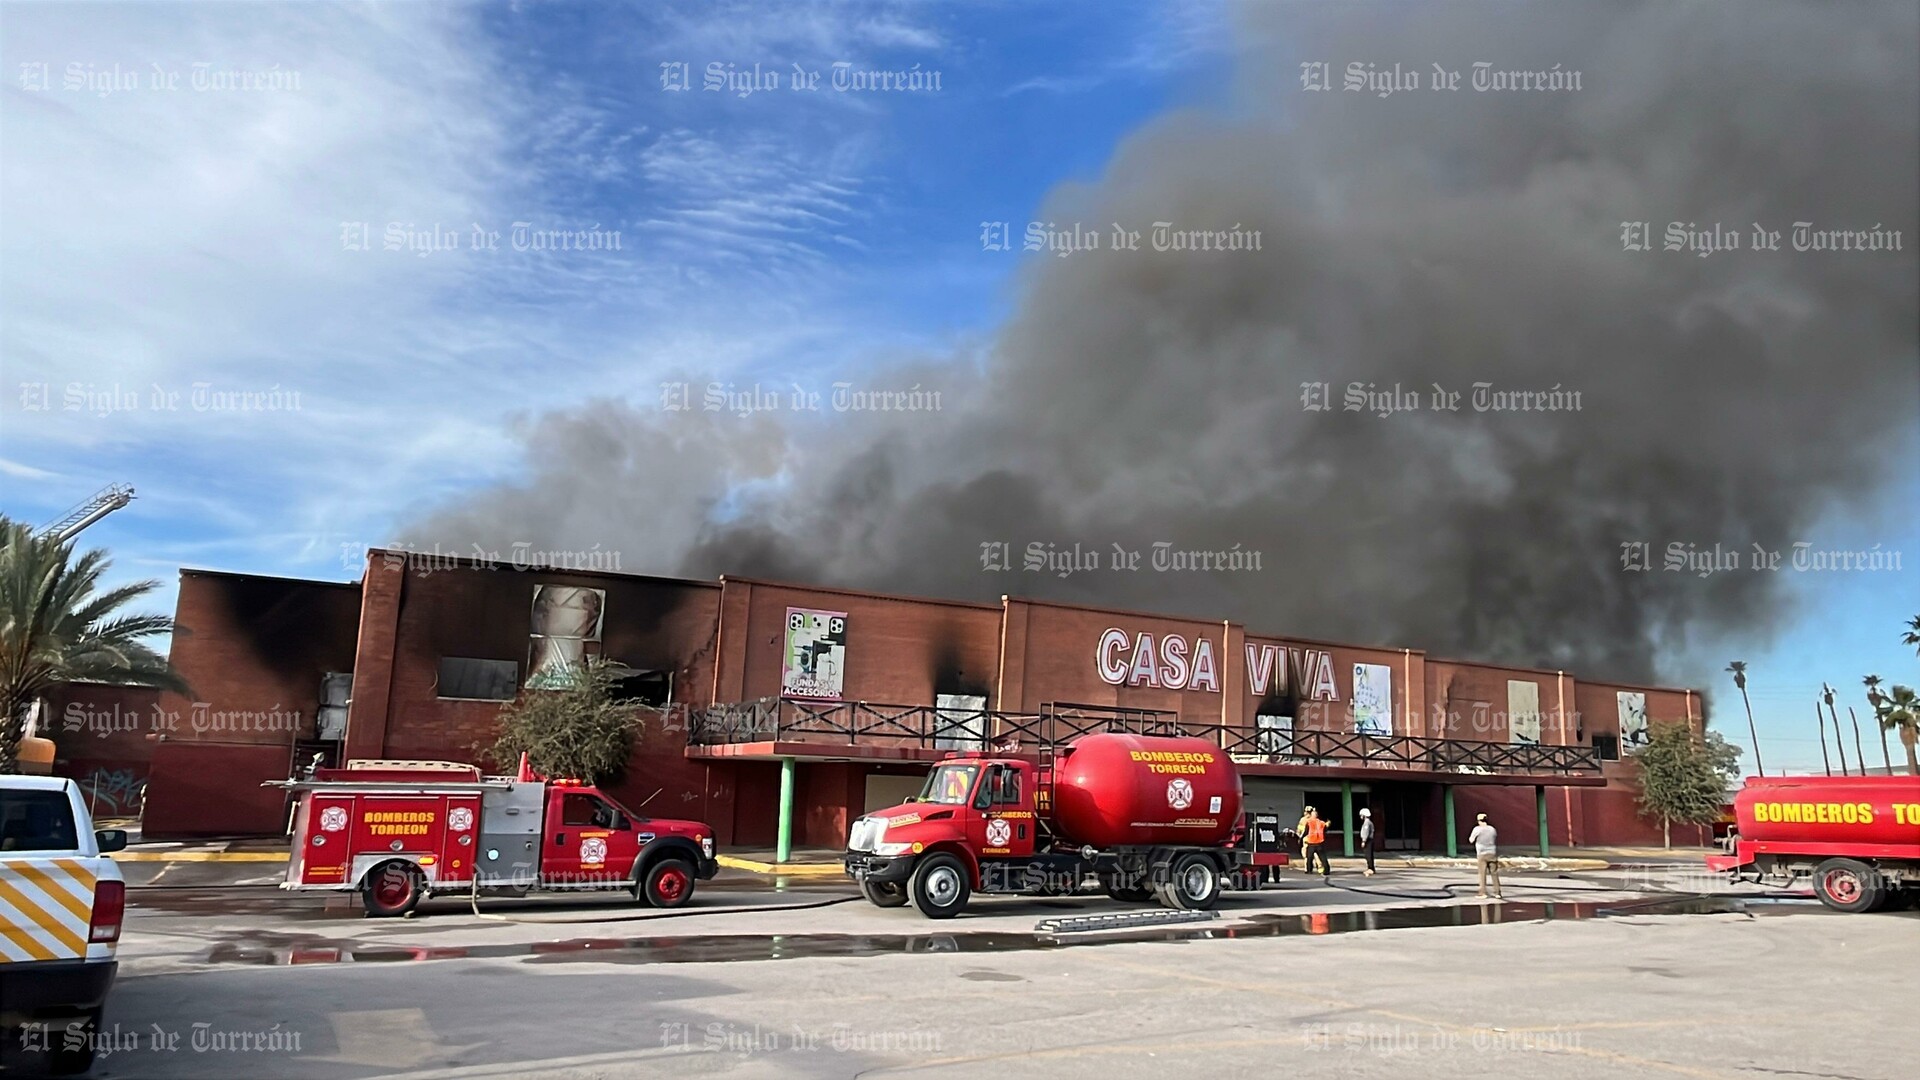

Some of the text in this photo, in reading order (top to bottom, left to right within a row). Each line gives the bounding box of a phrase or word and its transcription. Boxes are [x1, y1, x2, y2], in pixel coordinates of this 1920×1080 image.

[1096, 627, 1340, 701] CASA VIVA
[784, 687, 840, 698] ACCESORIOS
[1130, 751, 1214, 763] BOMBEROS
[1148, 763, 1206, 775] TORREÓN
[364, 812, 435, 823] BOMBEROS
[1754, 803, 1920, 825] BOMBEROS TO
